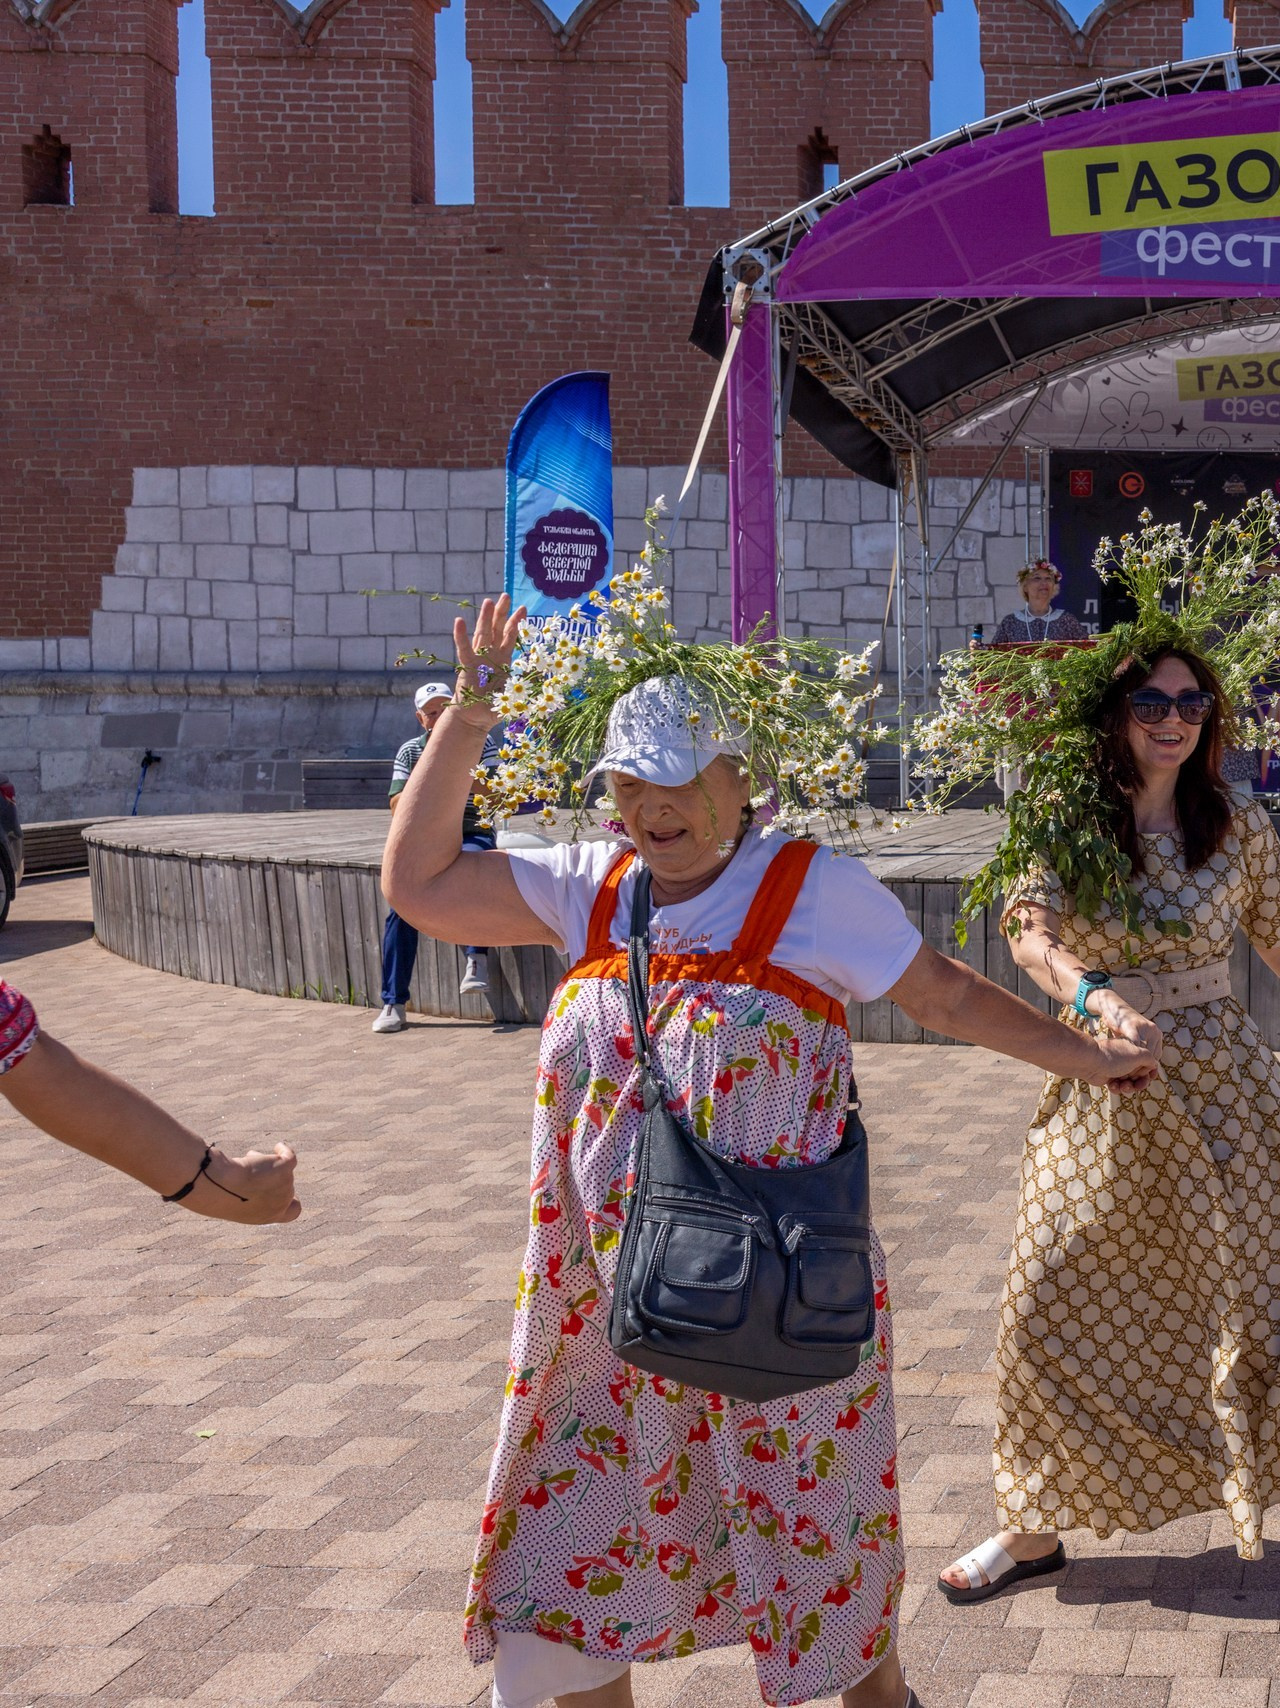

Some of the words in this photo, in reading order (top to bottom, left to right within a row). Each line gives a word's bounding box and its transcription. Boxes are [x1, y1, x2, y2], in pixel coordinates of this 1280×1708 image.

[537, 541, 598, 558] ФЕДЕРАЦИЯ
[542, 555, 592, 571] СЕВЕРНОЙ
[545, 568, 586, 583] ХОДЬБЫ
